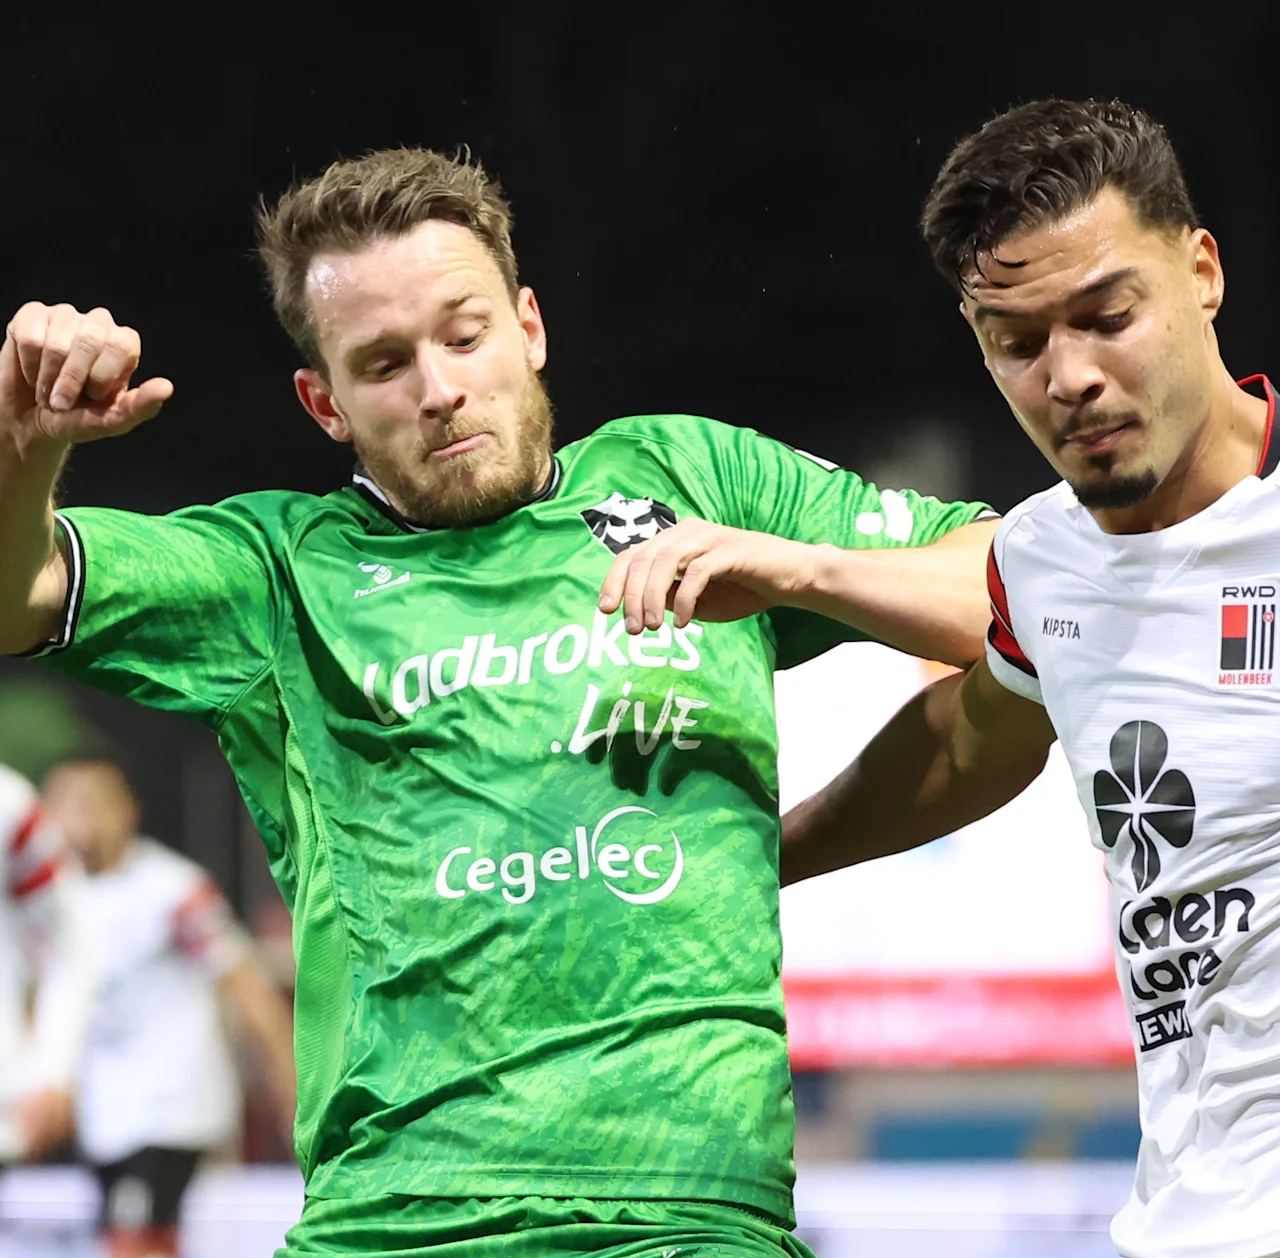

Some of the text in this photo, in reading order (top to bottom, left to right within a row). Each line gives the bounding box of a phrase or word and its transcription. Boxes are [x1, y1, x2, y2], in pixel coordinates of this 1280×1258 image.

[1222, 586, 1276, 598] RWD
[1042, 616, 1081, 639] KIPSTA
[363, 607, 703, 726] Ladbrokes
[1218, 673, 1273, 685] MOLENBEEK
[435, 826, 663, 904] Cegelec
